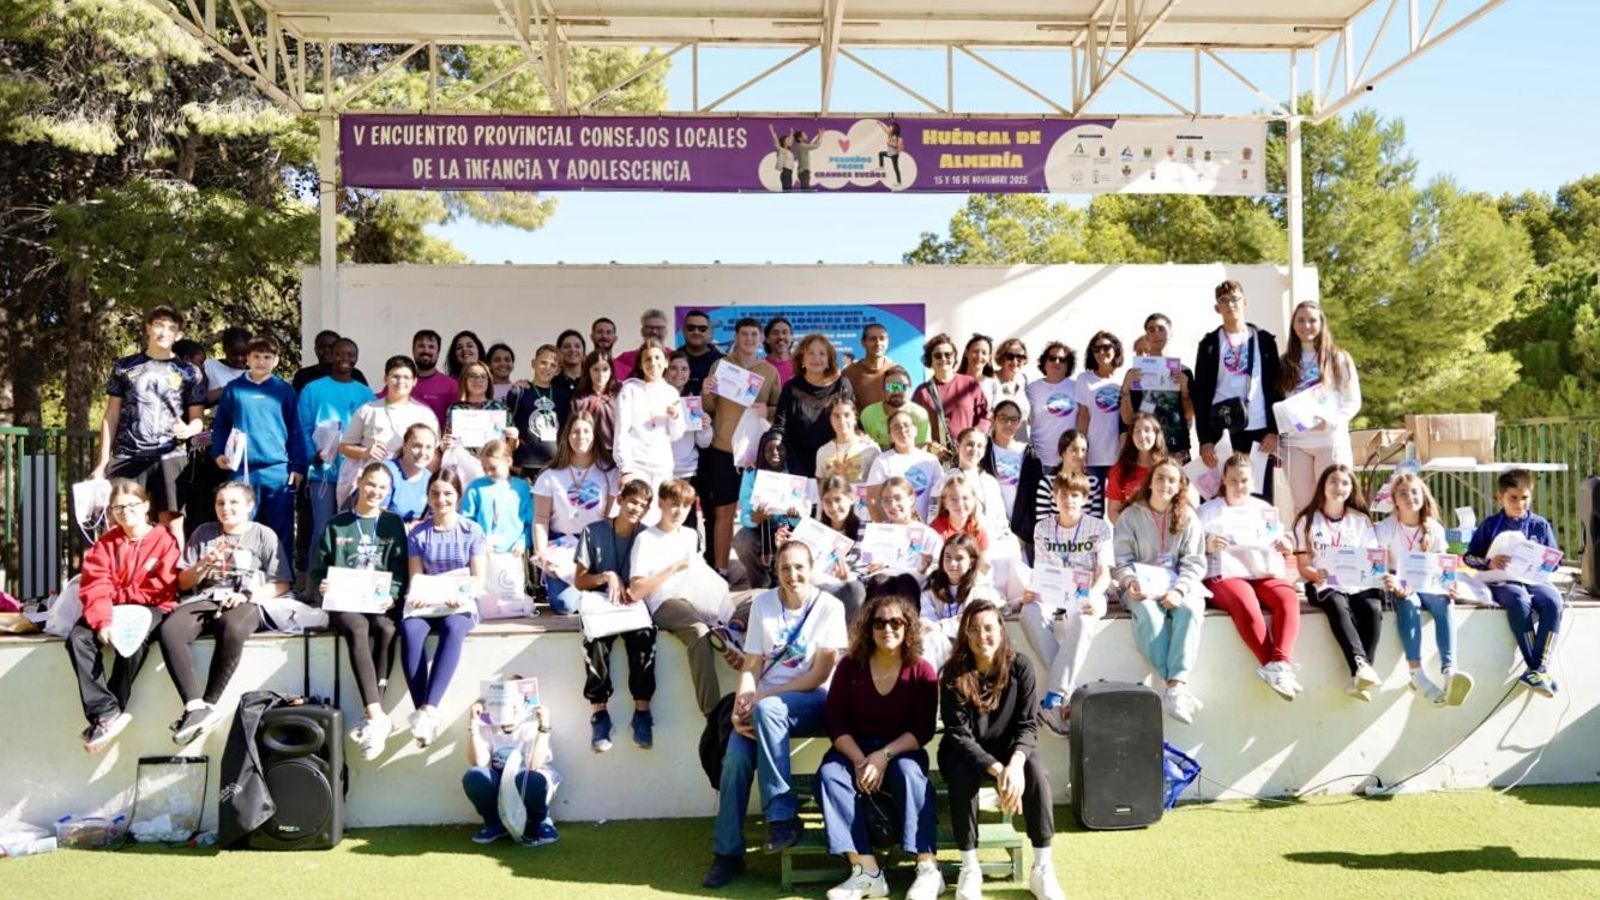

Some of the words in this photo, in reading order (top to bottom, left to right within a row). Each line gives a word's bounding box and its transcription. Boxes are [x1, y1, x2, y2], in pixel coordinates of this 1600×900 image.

[353, 125, 365, 146] V
[371, 125, 468, 146] ENCUENTRO
[580, 126, 669, 148] CONSEJOS
[676, 127, 747, 148] LOCALES
[1016, 130, 1041, 145] DE
[412, 157, 432, 180] DE
[439, 158, 460, 180] LA
[548, 159, 560, 180] Y
[939, 150, 1024, 169] ALMERÍA
[934, 175, 943, 184] 15
[945, 175, 950, 184] Y
[952, 175, 960, 184] 16
[962, 175, 970, 184] DE
[972, 175, 1008, 184] NOVIEMBRE
[1009, 175, 1028, 185] 2025
